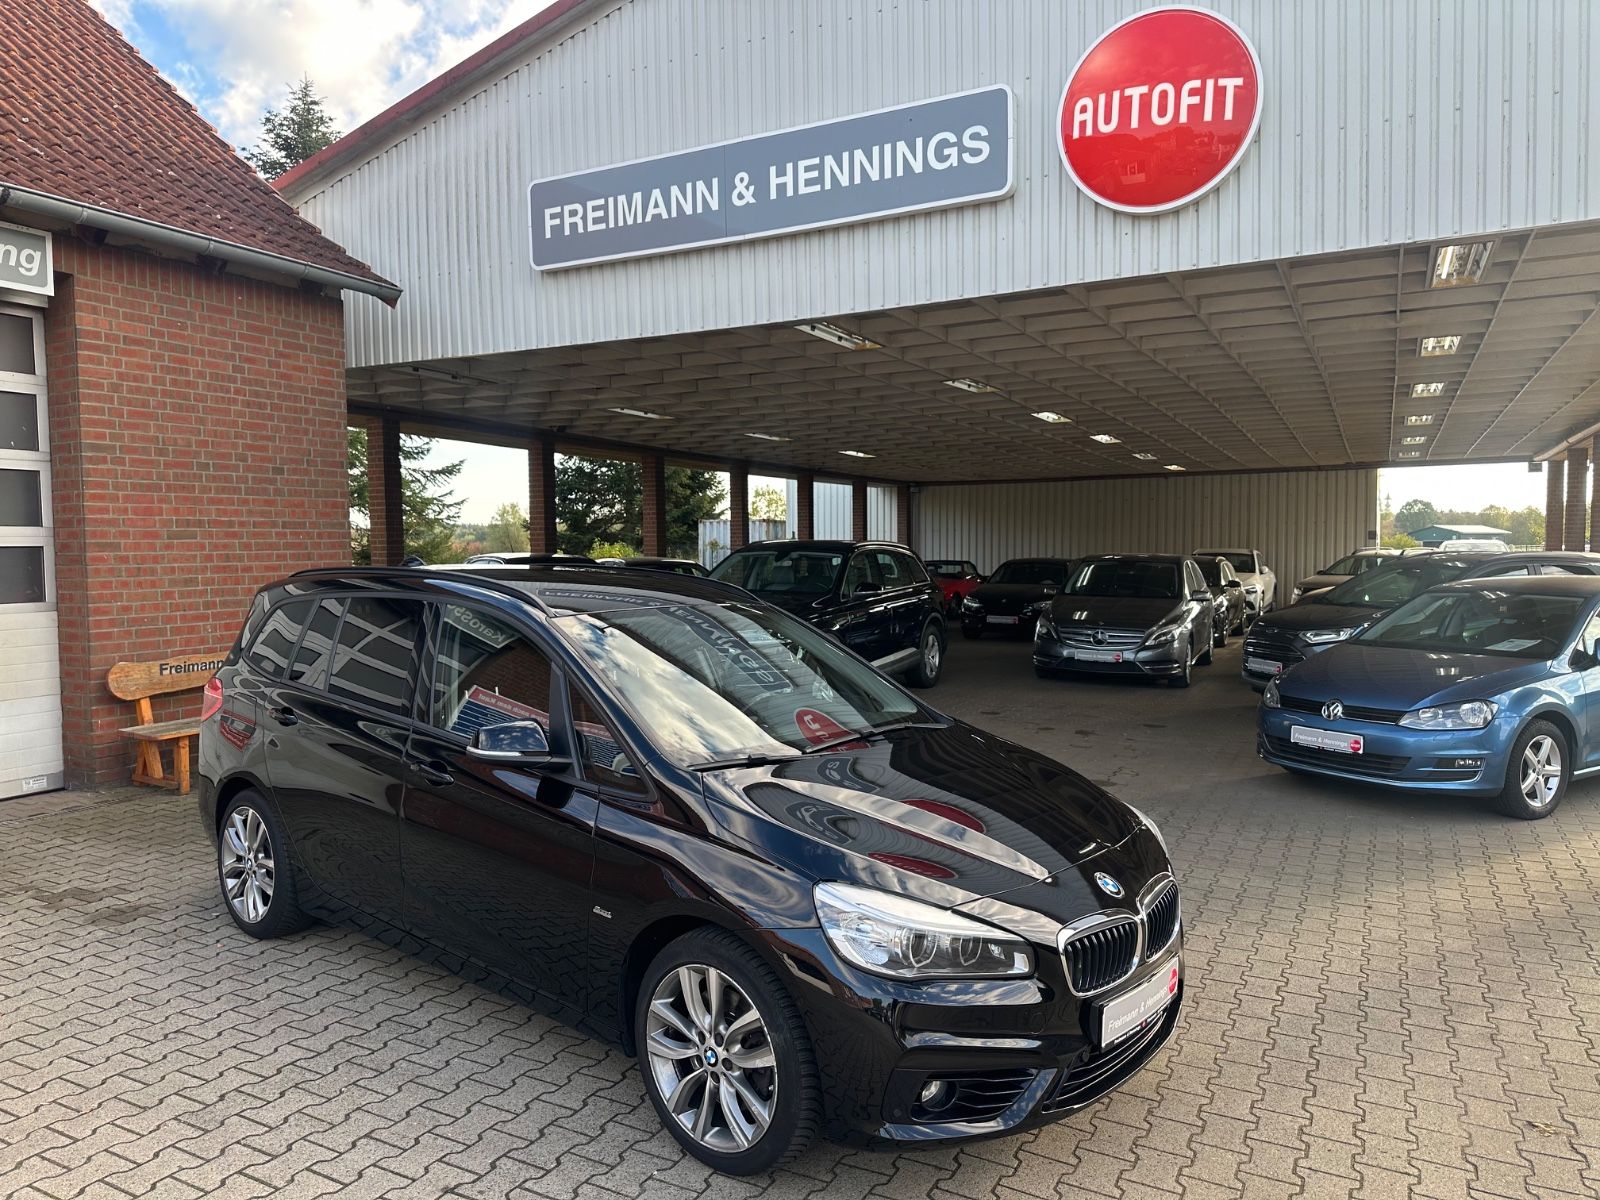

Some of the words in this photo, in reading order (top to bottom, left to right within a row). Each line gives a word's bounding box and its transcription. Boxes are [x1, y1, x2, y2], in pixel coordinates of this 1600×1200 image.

[1072, 77, 1244, 140] AUTOFIT
[544, 177, 719, 239] FREIMANN
[731, 171, 757, 207] &
[769, 125, 990, 200] HENNINGS
